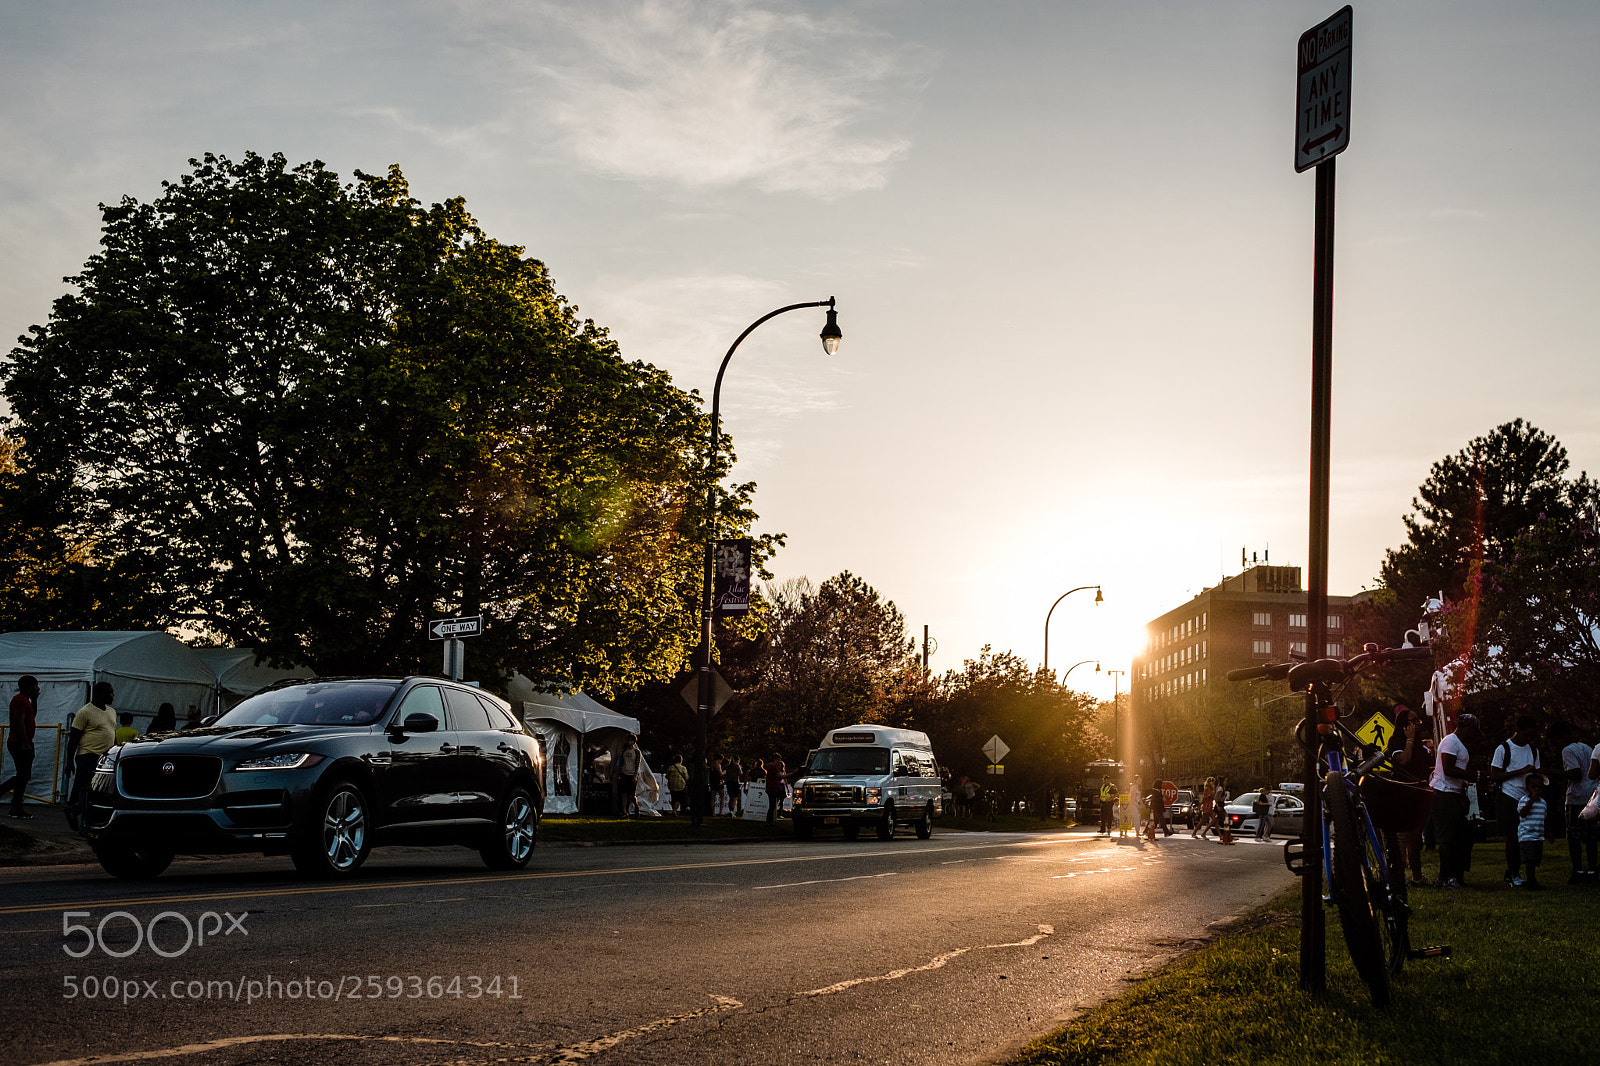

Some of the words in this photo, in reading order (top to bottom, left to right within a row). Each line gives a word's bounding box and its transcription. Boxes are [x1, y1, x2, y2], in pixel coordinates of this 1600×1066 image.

[1301, 37, 1316, 68] NO
[1318, 21, 1348, 54] PARKING
[1308, 61, 1340, 103] ANY
[1304, 91, 1342, 133] TIME
[728, 583, 746, 595] Lilac
[441, 624, 457, 632] ONE
[460, 622, 476, 630] WAY
[1161, 788, 1177, 799] TOP
